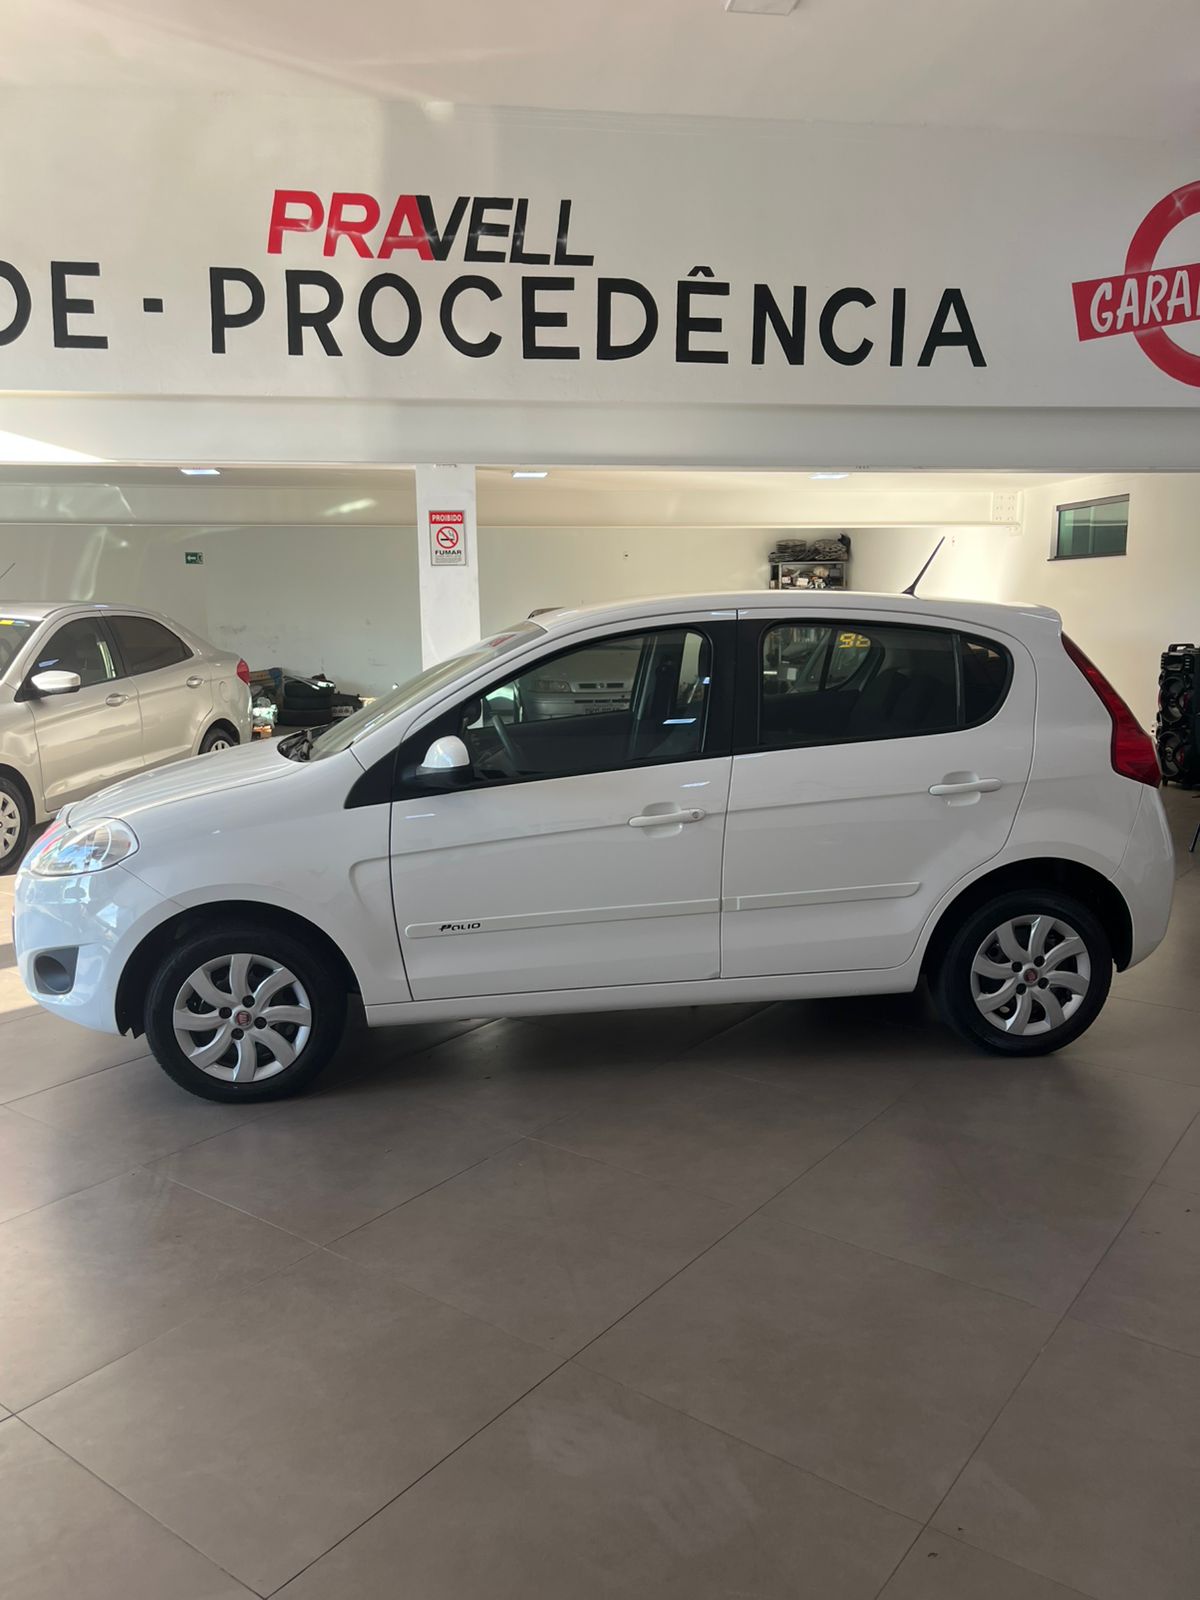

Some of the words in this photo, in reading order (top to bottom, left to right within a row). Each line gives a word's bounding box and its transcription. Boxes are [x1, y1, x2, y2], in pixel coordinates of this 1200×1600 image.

[267, 189, 594, 266] PRAVELL
[209, 266, 987, 367] PROCEDÊNCIA
[1090, 269, 1200, 333] GARA
[431, 514, 463, 522] PROIBIDO
